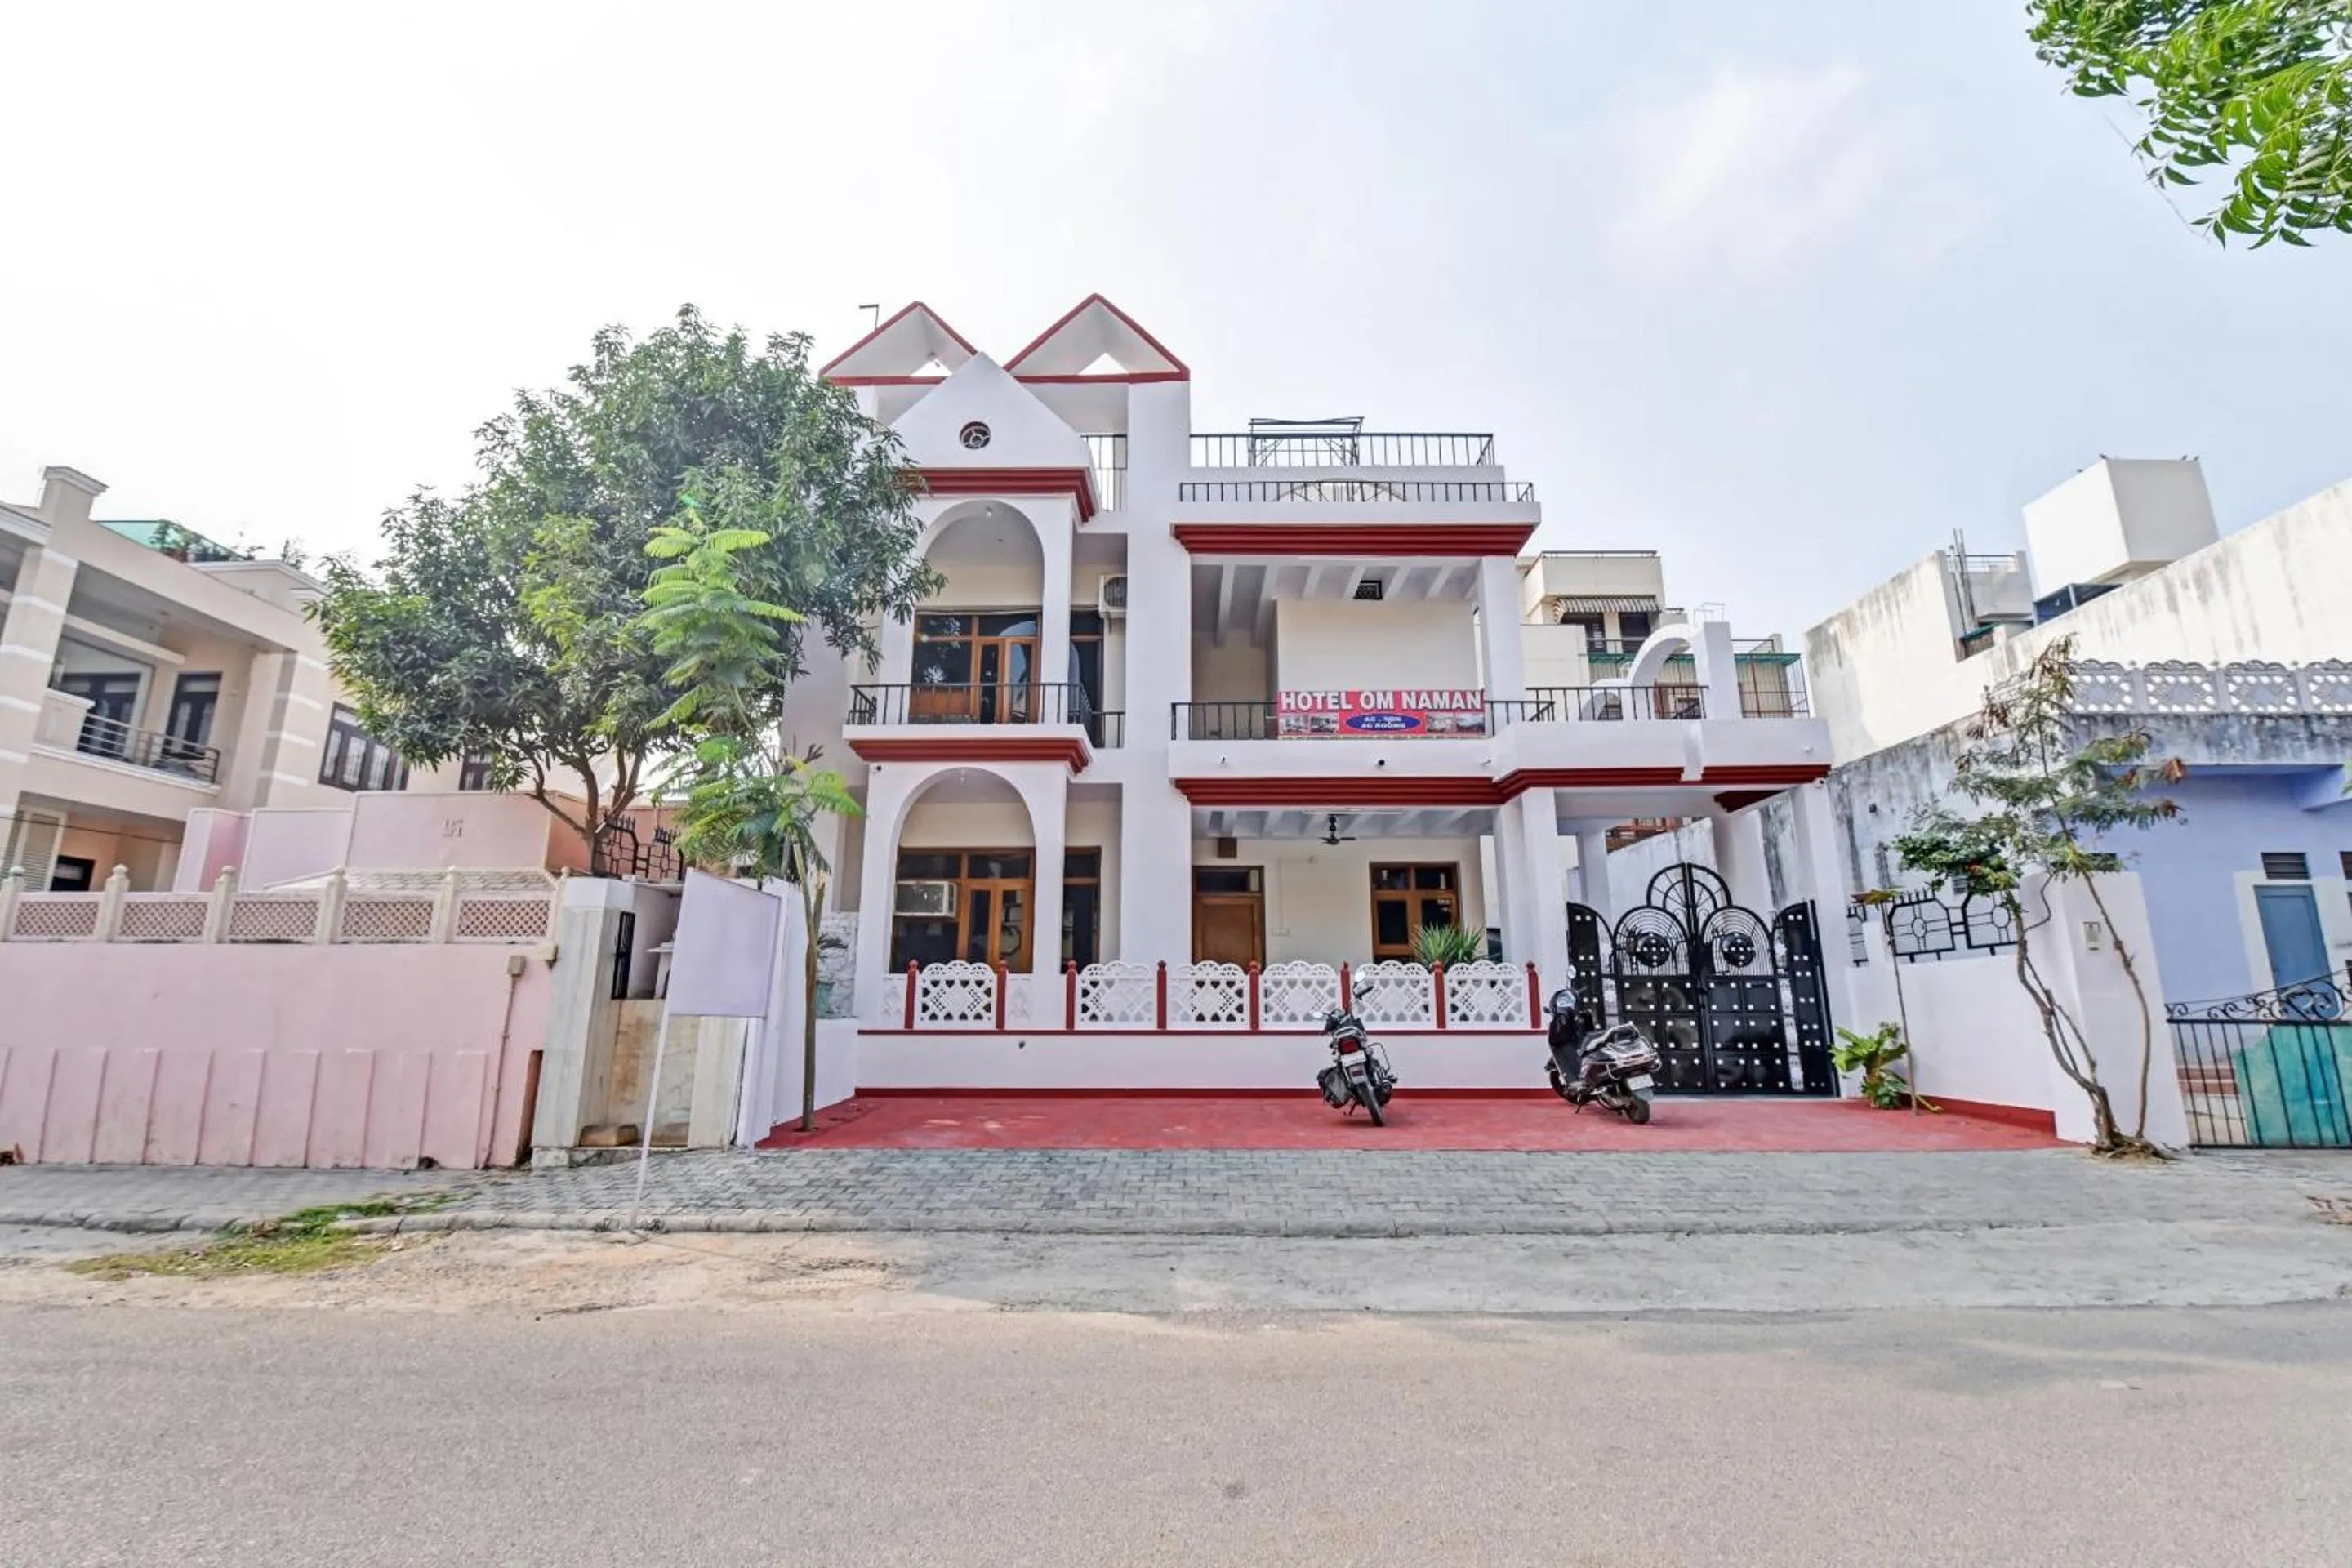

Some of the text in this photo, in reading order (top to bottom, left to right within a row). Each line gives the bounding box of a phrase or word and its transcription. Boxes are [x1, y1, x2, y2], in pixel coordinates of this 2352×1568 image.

[1281, 691, 1481, 710] HOTEL OM NAMAN
